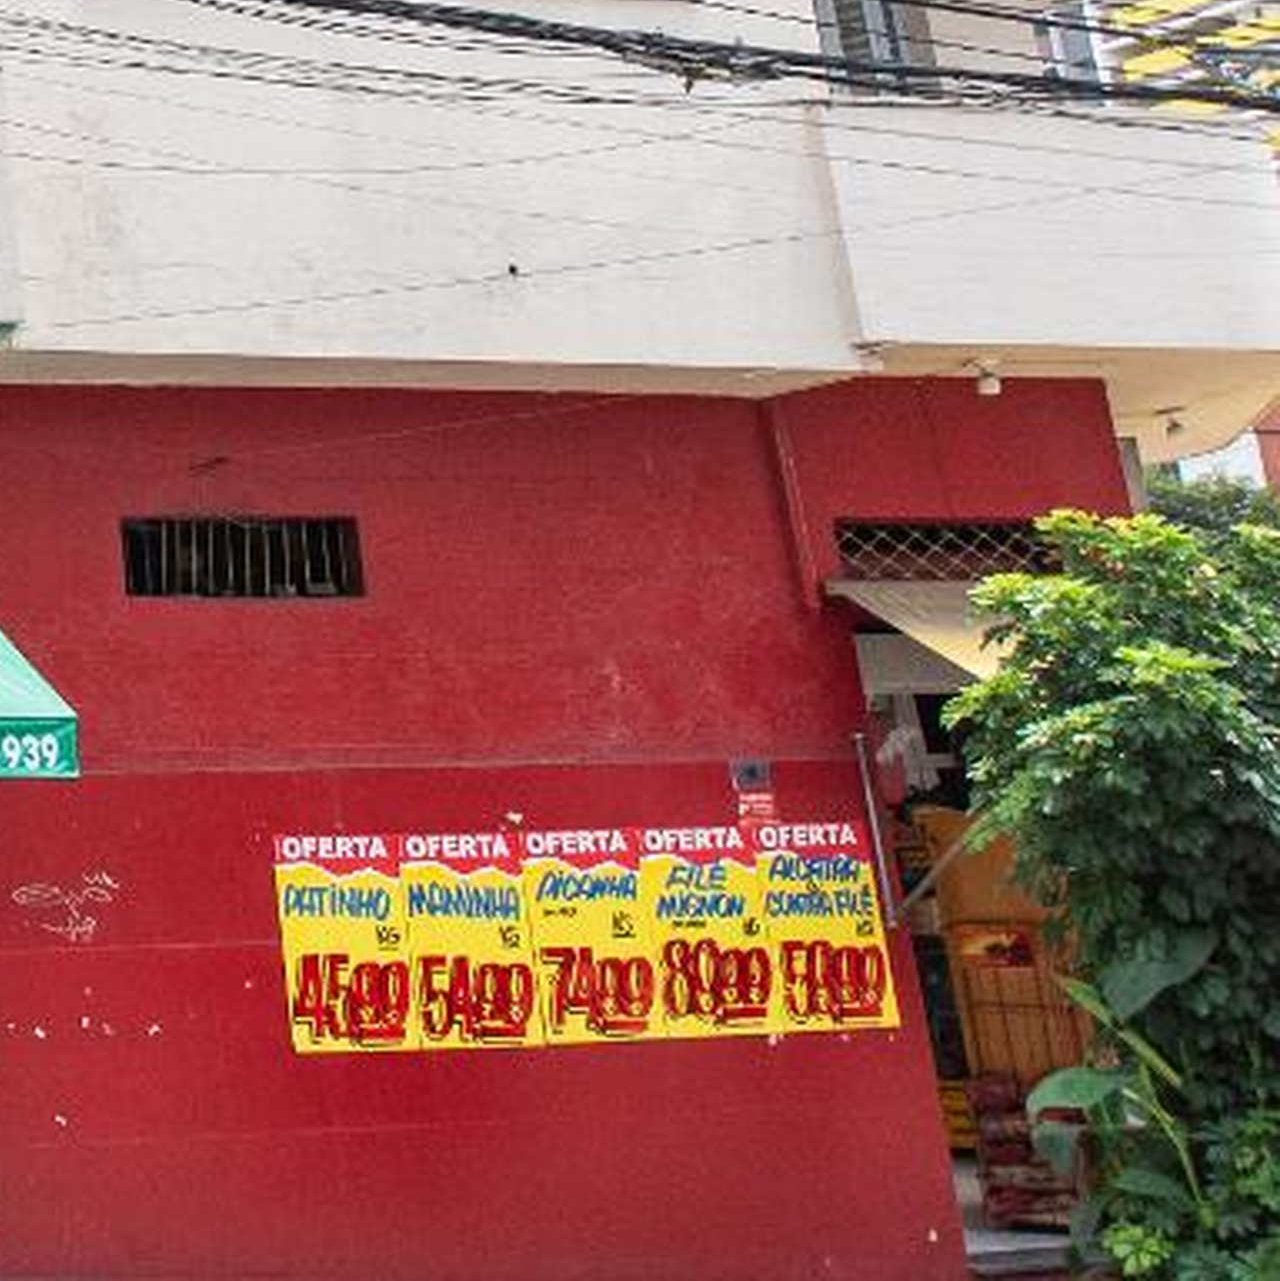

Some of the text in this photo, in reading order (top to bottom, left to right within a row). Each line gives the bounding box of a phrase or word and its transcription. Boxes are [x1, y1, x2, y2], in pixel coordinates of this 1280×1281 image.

[281, 836, 388, 860] OFERTA
[405, 834, 510, 858] OFERTA
[526, 830, 628, 855] OFERTA
[644, 827, 744, 852] OFERTA
[758, 823, 858, 849] OFERTA
[408, 879, 520, 921] MAMINHA
